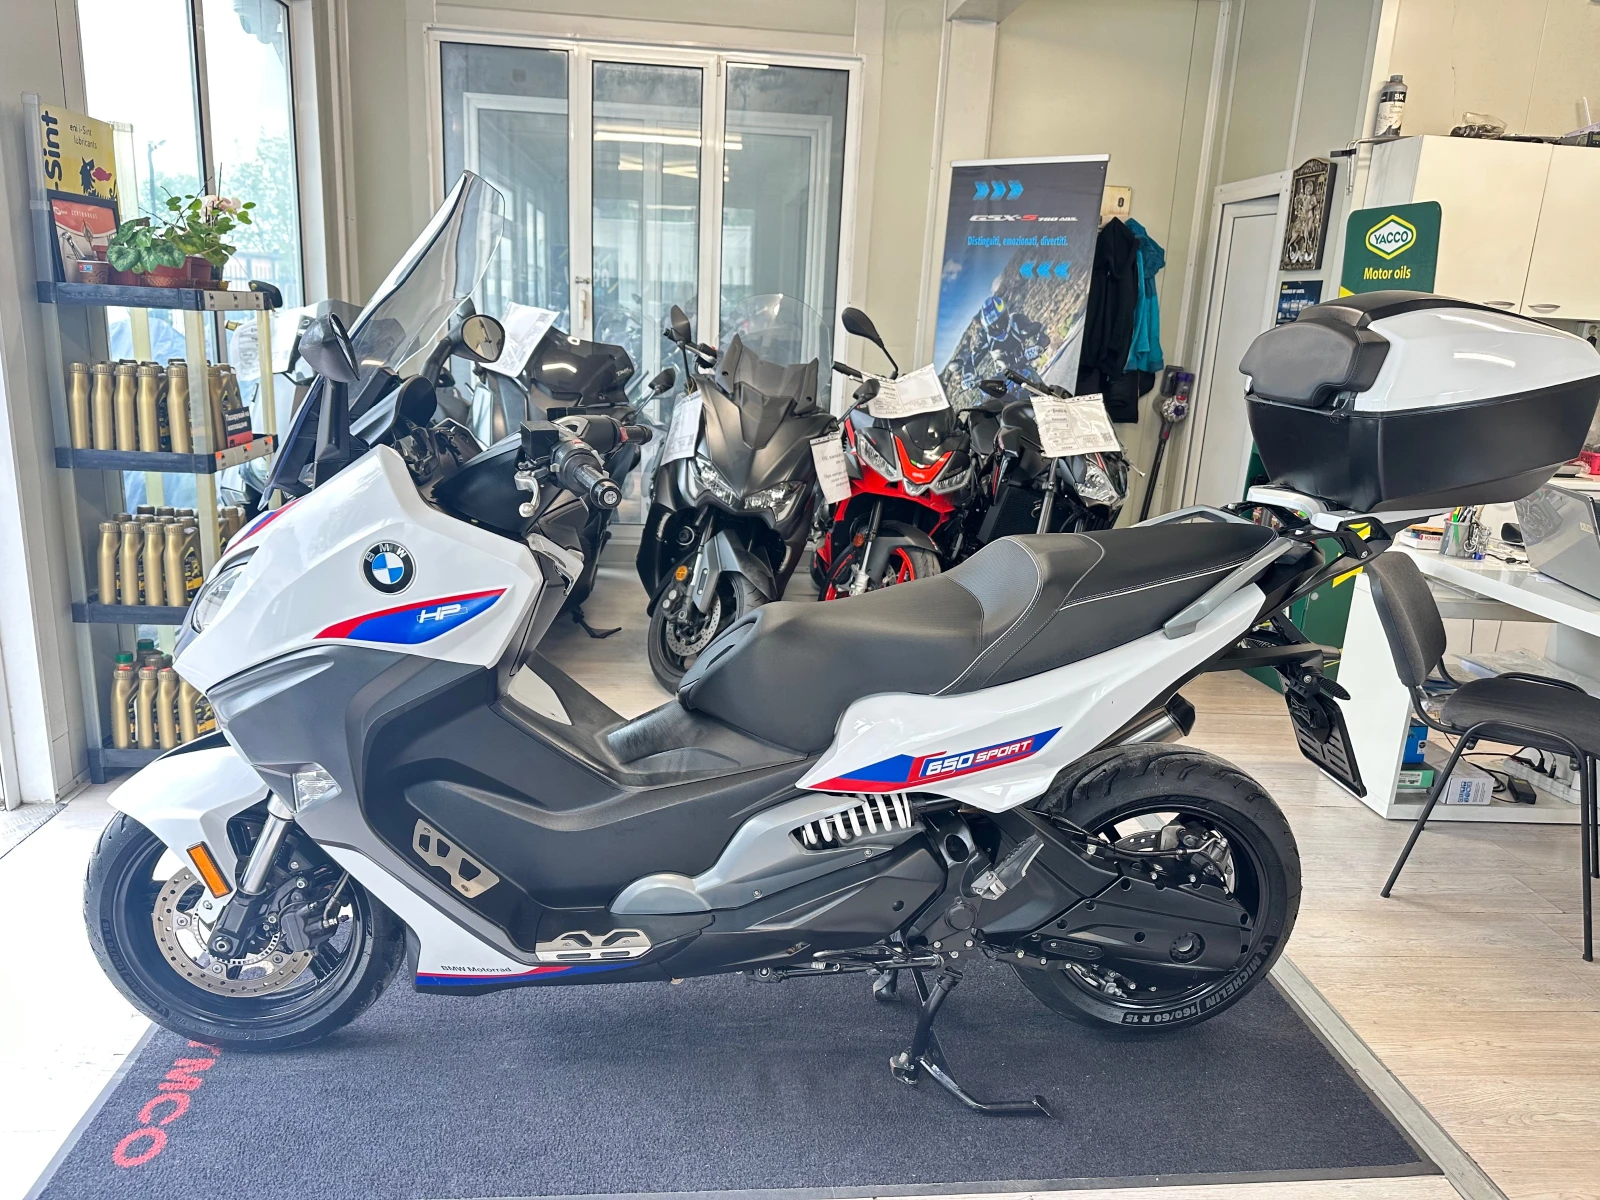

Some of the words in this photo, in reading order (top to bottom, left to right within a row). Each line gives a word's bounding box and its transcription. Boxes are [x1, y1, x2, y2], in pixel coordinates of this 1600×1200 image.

[74, 135, 98, 149] lubricants
[967, 235, 1001, 248] Distinguiti,
[1002, 235, 1039, 248] emozionati,
[1040, 235, 1069, 247] divertiti.
[1374, 230, 1409, 244] YACCO
[1363, 267, 1393, 280] Motor
[1393, 265, 1411, 279] oils
[364, 542, 408, 563] BMW
[419, 604, 462, 623] HP
[926, 753, 974, 776] 650
[975, 741, 1032, 761] SPORT
[1205, 956, 1262, 1007] MICHELIN
[1125, 1013, 1139, 1023] 15
[1141, 1014, 1151, 1023] R
[1153, 1006, 1199, 1023] 160/60
[112, 1039, 221, 1168] MCO
